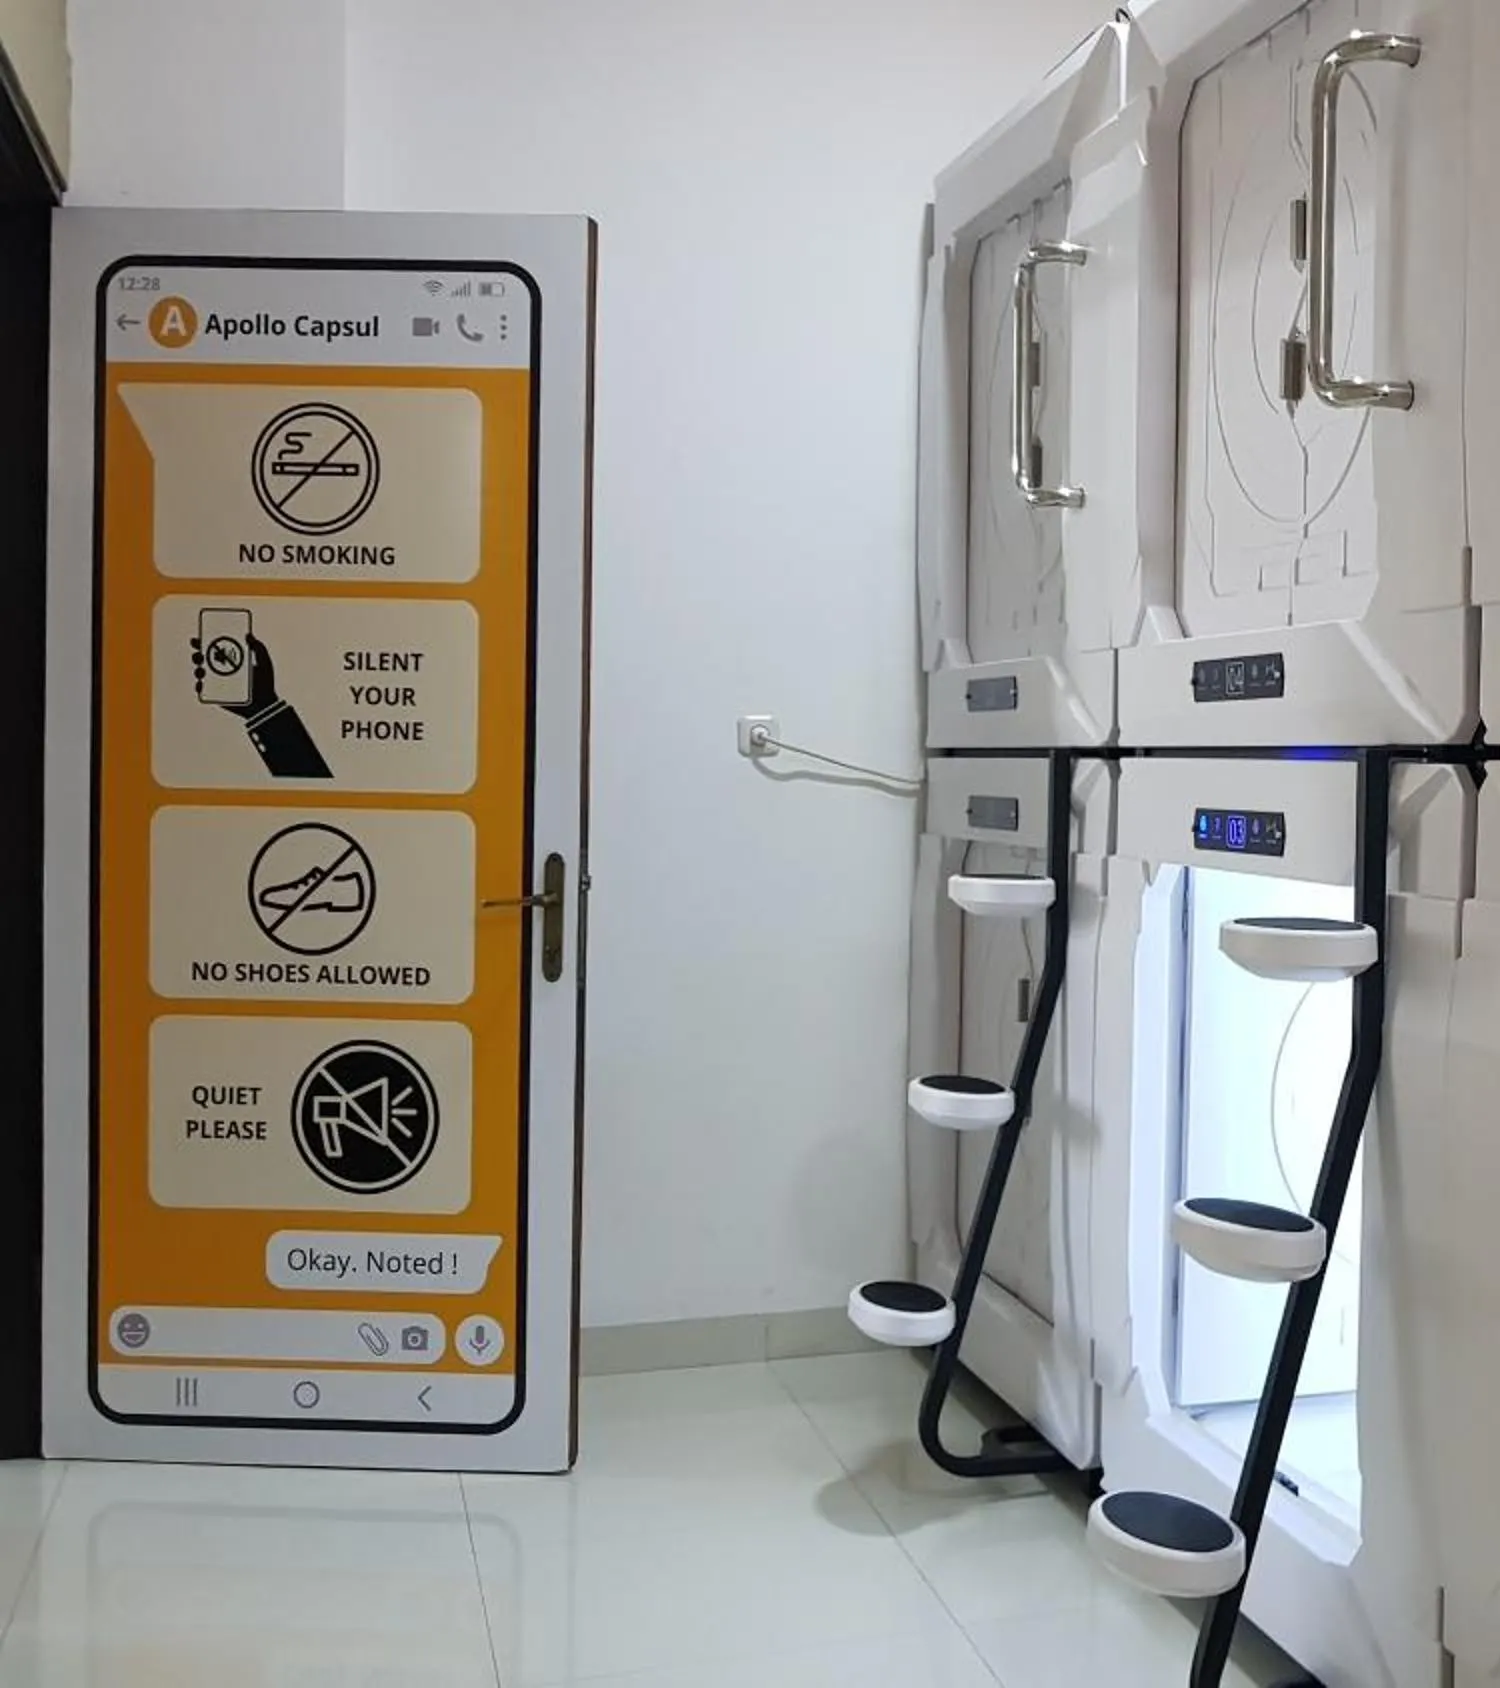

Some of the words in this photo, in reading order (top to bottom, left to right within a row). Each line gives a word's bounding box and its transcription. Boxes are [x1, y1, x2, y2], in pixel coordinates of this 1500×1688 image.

[204, 313, 287, 340] Apollo
[294, 315, 380, 342] Capsul
[239, 544, 275, 563] NO
[282, 545, 396, 565] SMOKING
[343, 651, 424, 672] SILENT
[350, 686, 416, 706] YOUR
[341, 720, 424, 740] PHONE
[192, 962, 228, 981] NO
[235, 963, 310, 984] SHOES
[316, 966, 431, 986] ALLOWED
[191, 1085, 263, 1108] QUIET
[186, 1120, 267, 1140] PLEASE
[287, 1248, 358, 1278] Okay.
[366, 1251, 444, 1275] Noted
